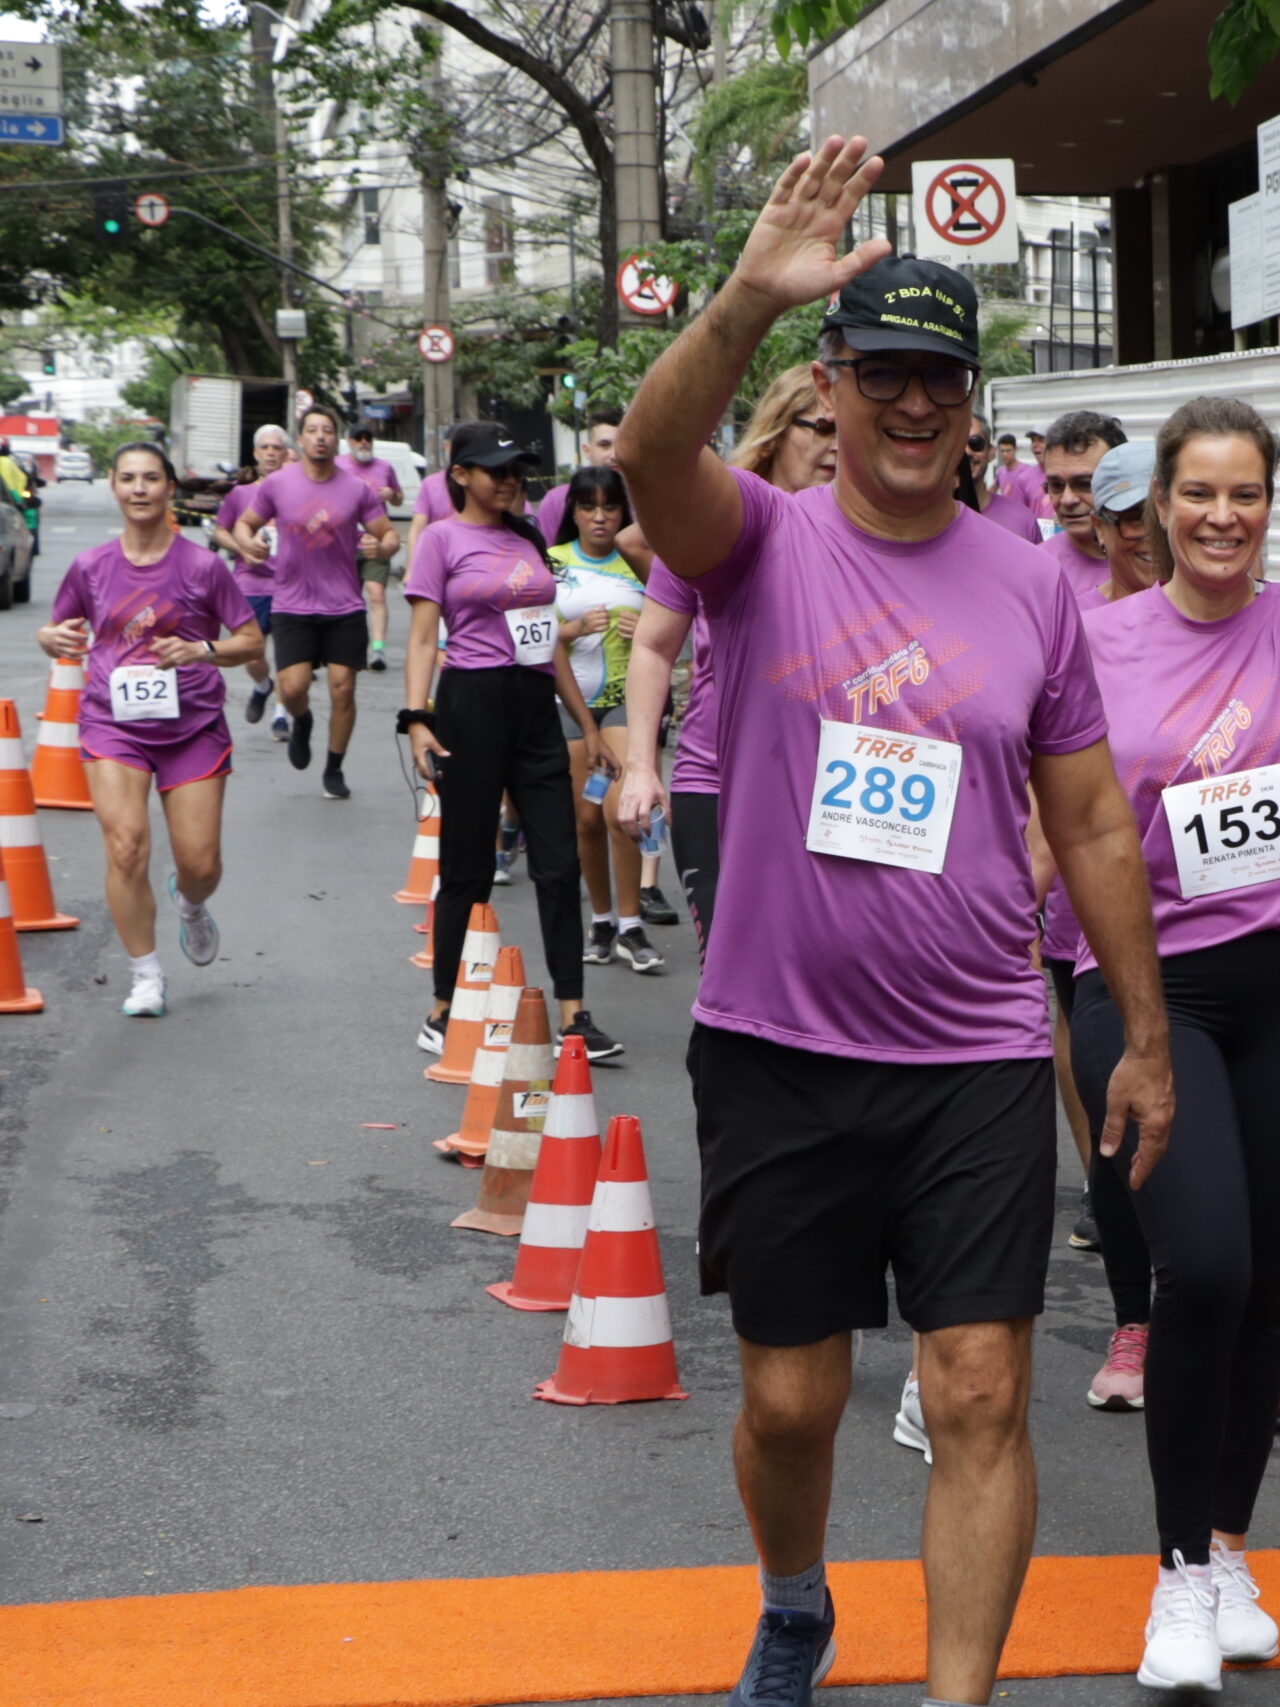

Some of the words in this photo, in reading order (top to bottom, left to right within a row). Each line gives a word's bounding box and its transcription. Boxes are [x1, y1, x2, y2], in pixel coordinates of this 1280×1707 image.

[898, 286, 934, 298] BDA
[880, 313, 920, 328] BRIGADA
[515, 621, 552, 646] 267
[117, 680, 168, 702] 152
[847, 647, 930, 725] TRF6
[852, 737, 918, 764] TRF6
[1192, 701, 1252, 780] TRF6
[820, 760, 936, 823] 289
[1198, 780, 1252, 806] TRF6
[855, 816, 927, 838] VASCONCELOS
[1202, 852, 1237, 866] RENATA
[1238, 844, 1276, 860] PIMENTA
